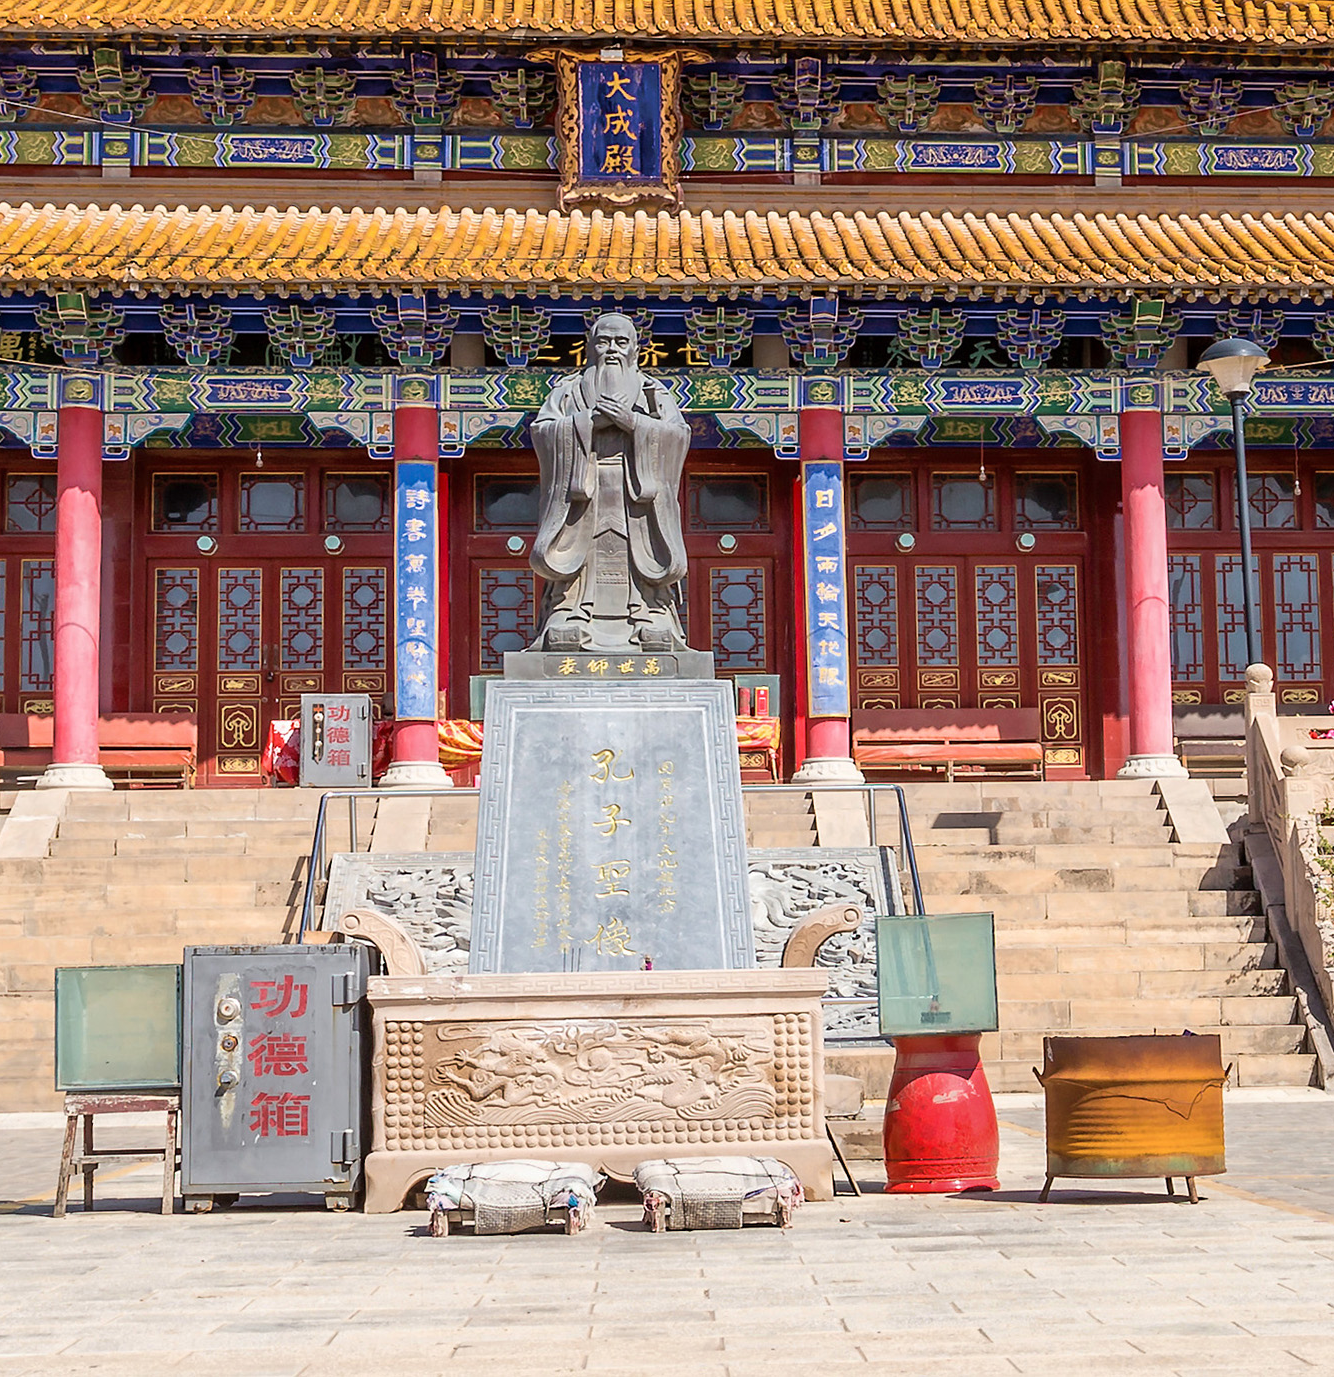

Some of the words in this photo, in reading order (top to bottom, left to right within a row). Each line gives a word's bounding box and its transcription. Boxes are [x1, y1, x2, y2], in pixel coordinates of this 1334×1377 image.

[601, 71, 640, 174] 大成殿
[327, 705, 351, 766] 功德箱
[584, 748, 637, 956] 孔子聖像
[247, 974, 311, 1137] 功德箱
